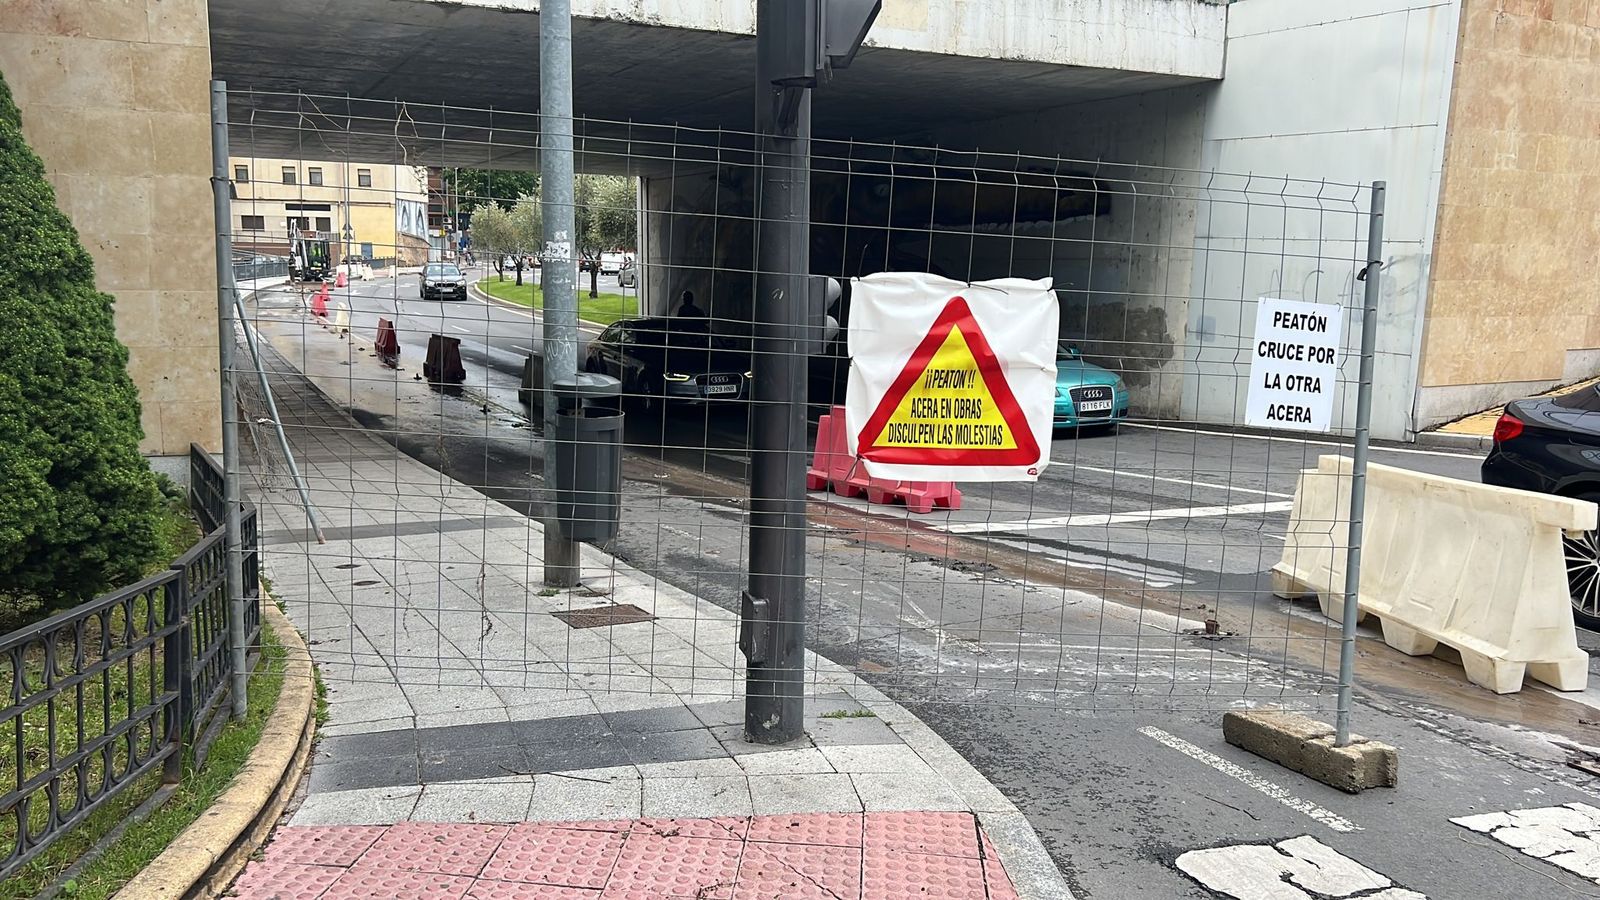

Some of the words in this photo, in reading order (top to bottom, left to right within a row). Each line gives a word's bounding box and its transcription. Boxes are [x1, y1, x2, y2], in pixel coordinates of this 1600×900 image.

[1273, 311, 1327, 333] PEATÓN
[1258, 341, 1304, 361] CRUCE
[1307, 346, 1335, 364] POR
[1264, 372, 1281, 389] LA
[1285, 374, 1321, 393] OTRA
[911, 397, 939, 419] ACERA
[940, 398, 952, 418] EN
[953, 398, 982, 419] OBRAS
[1266, 403, 1312, 423] ACERA
[888, 422, 935, 444] DISCULPEN
[937, 423, 953, 445] LAS
[955, 424, 1003, 446] MOLESTIAS
